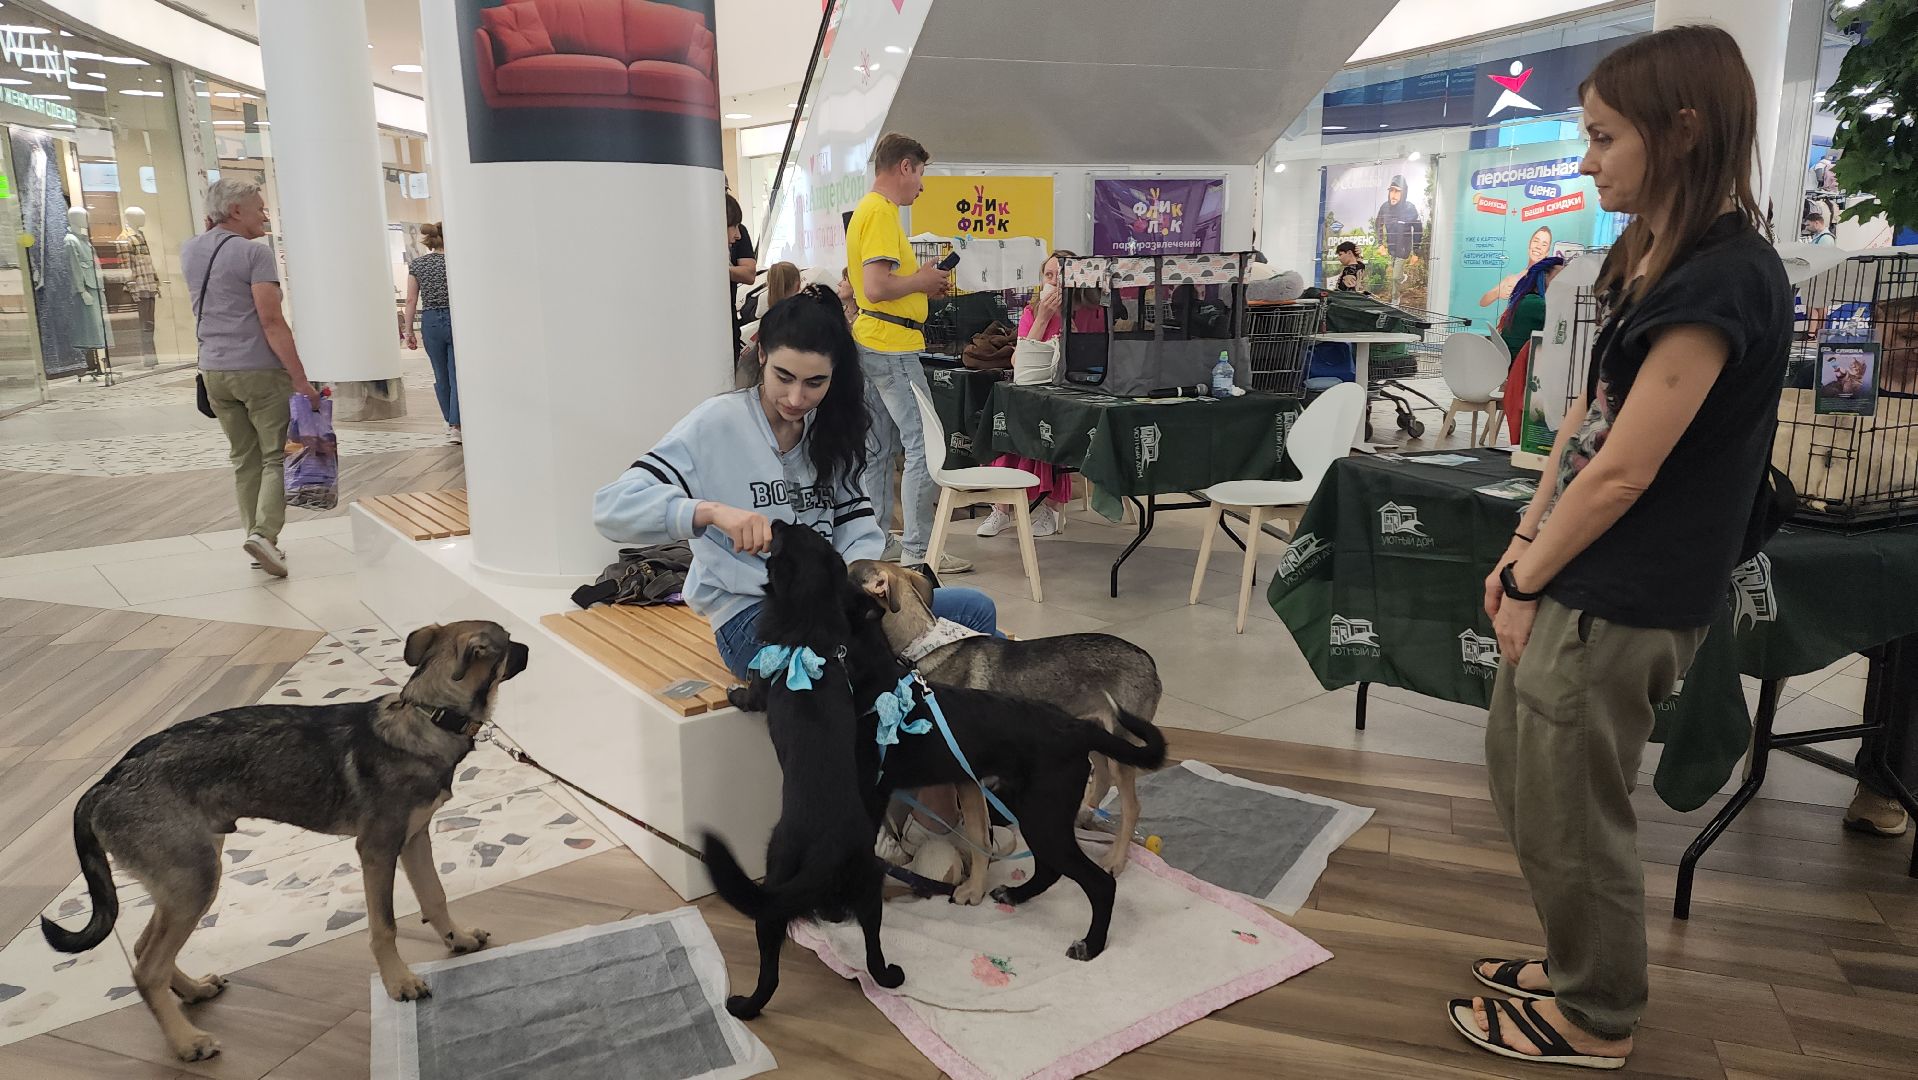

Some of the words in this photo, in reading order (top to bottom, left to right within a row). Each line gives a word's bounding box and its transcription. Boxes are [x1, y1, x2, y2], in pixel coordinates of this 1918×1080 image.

[1476, 161, 1579, 187] персональная
[1529, 184, 1557, 197] цена
[956, 198, 1010, 217] ФЛИК
[1139, 239, 1201, 250] развлечений
[1381, 535, 1415, 546] УЮТНЫЙ
[1416, 537, 1435, 548] ДОМ
